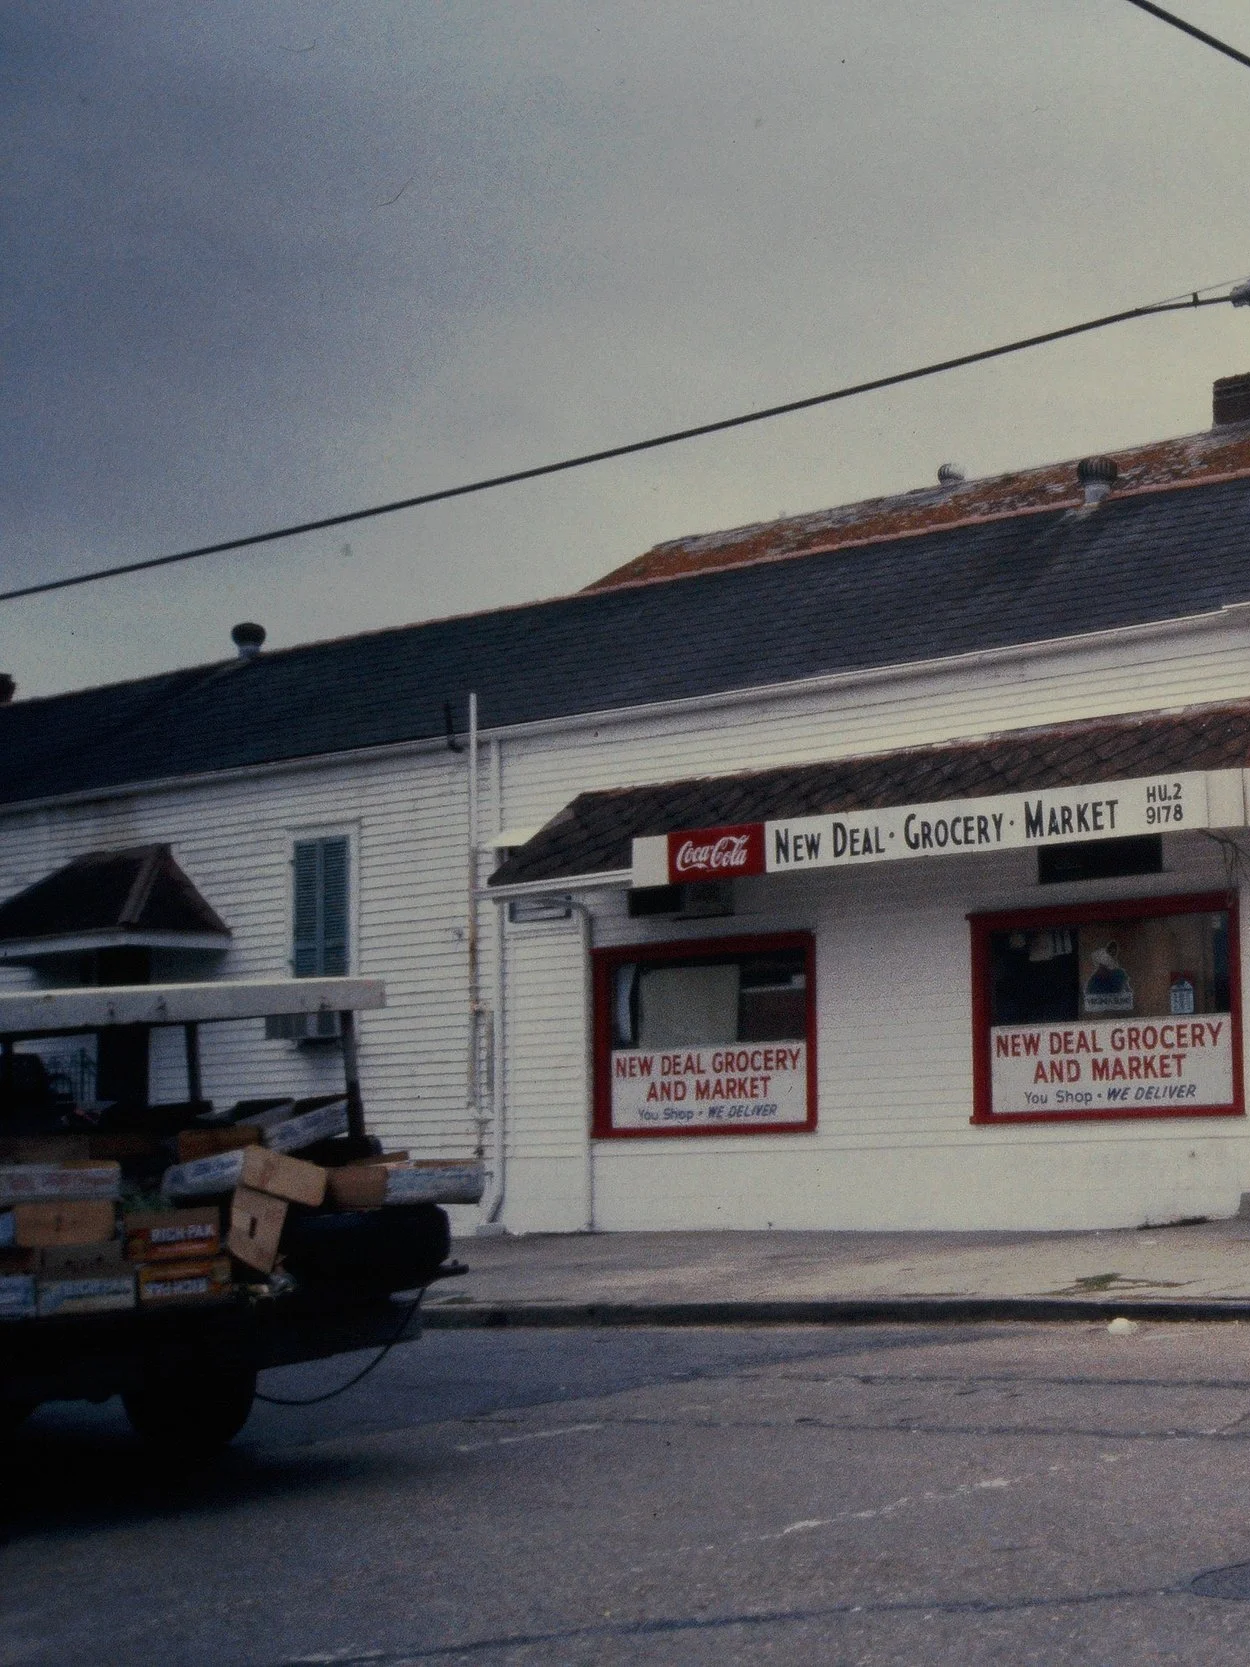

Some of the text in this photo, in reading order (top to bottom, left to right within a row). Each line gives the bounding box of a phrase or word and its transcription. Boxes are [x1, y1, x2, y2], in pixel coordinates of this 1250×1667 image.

[1145, 804, 1184, 825] 9178
[676, 834, 749, 872] Coca-Cola
[995, 1021, 1223, 1058] NEW DEAL GROCERY
[615, 1048, 801, 1078] NEW DEAL GROCERY
[1034, 1054, 1187, 1085] AND MARKET
[646, 1076, 771, 1102] AND MARKET
[1024, 1084, 1197, 1105] You Shop WE DELIVER
[638, 1104, 778, 1122] You Shop WE DELIVER
